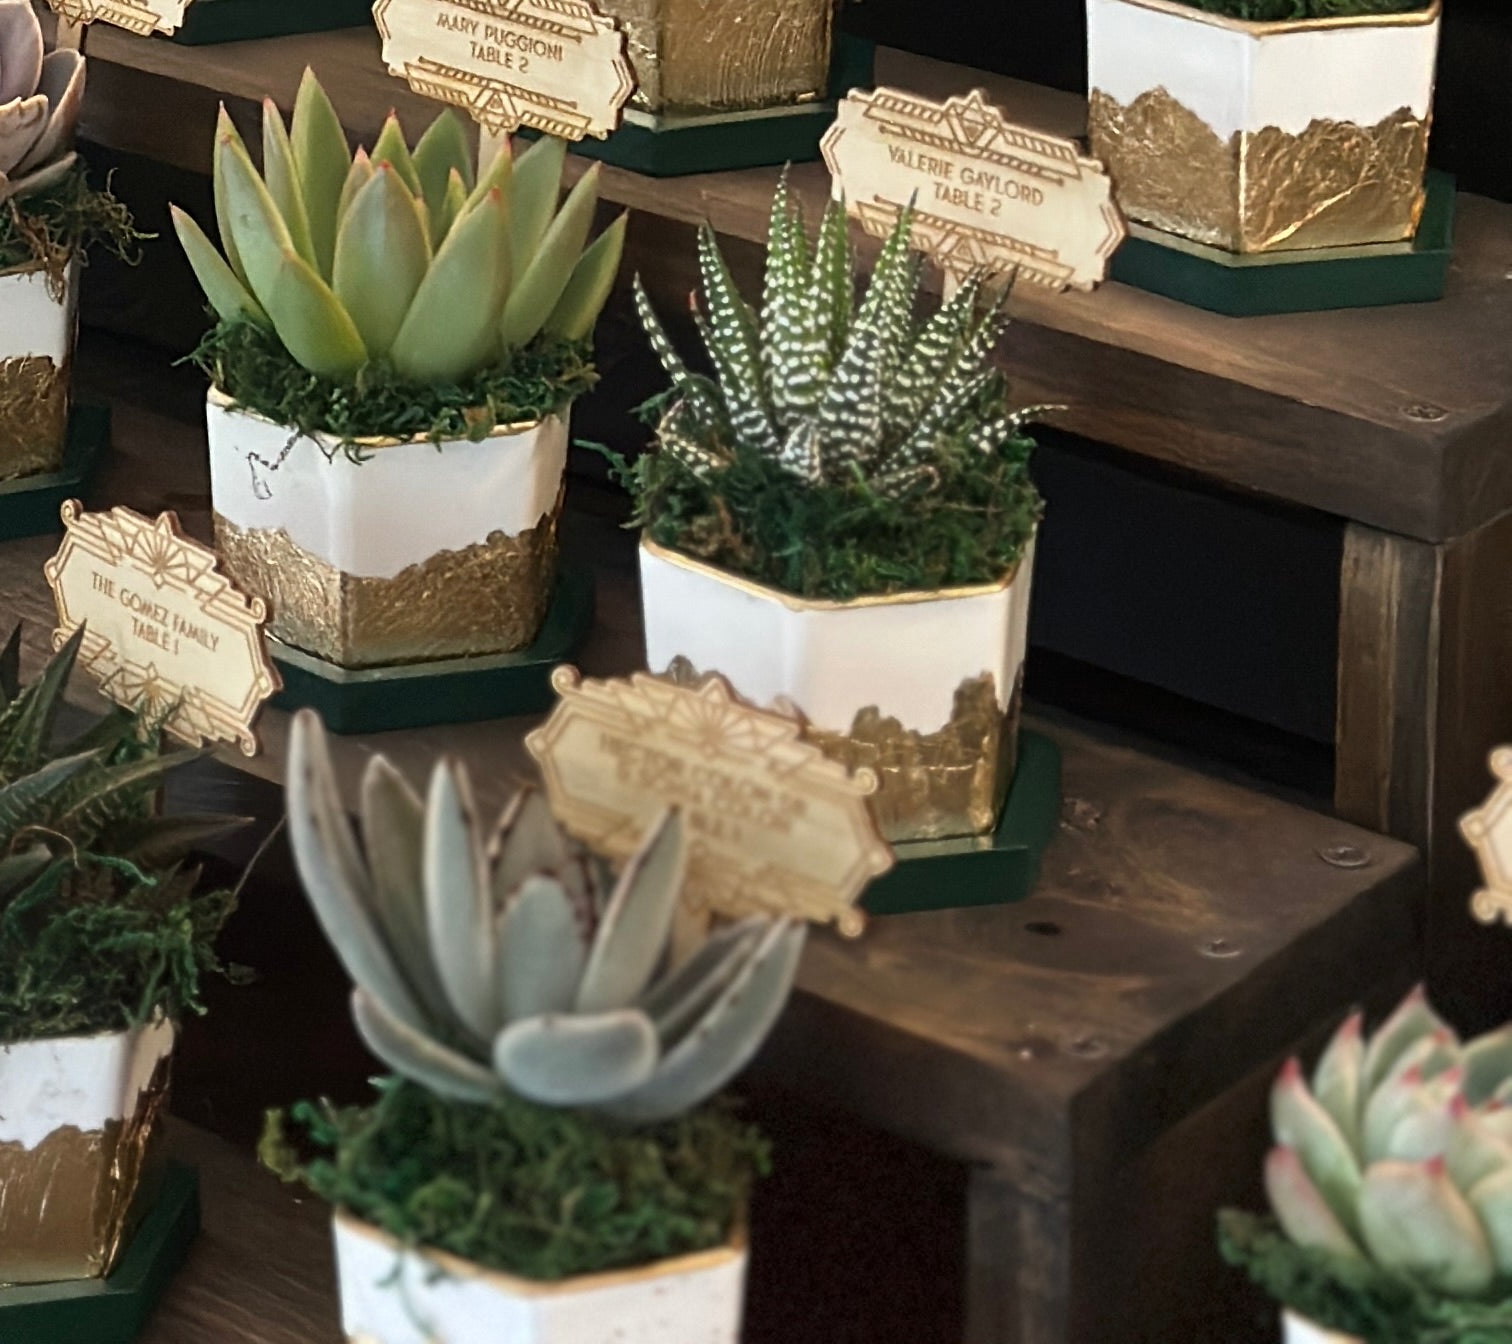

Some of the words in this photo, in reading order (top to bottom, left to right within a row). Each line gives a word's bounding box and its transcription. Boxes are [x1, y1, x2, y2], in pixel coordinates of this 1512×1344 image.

[436, 11, 480, 38] MARY
[484, 24, 564, 62] PUGGIONI
[469, 40, 514, 69] TABLE
[519, 55, 530, 74] 2
[888, 143, 953, 182] VALERIE
[959, 165, 1045, 207] GAYLORD
[933, 181, 986, 213] TABLE
[989, 199, 1002, 217] 2
[91, 570, 115, 599] THE
[120, 587, 169, 627] GOMEZ
[172, 613, 220, 653] FAMILY
[131, 615, 170, 652] TABLE
[174, 638, 179, 656] 1
